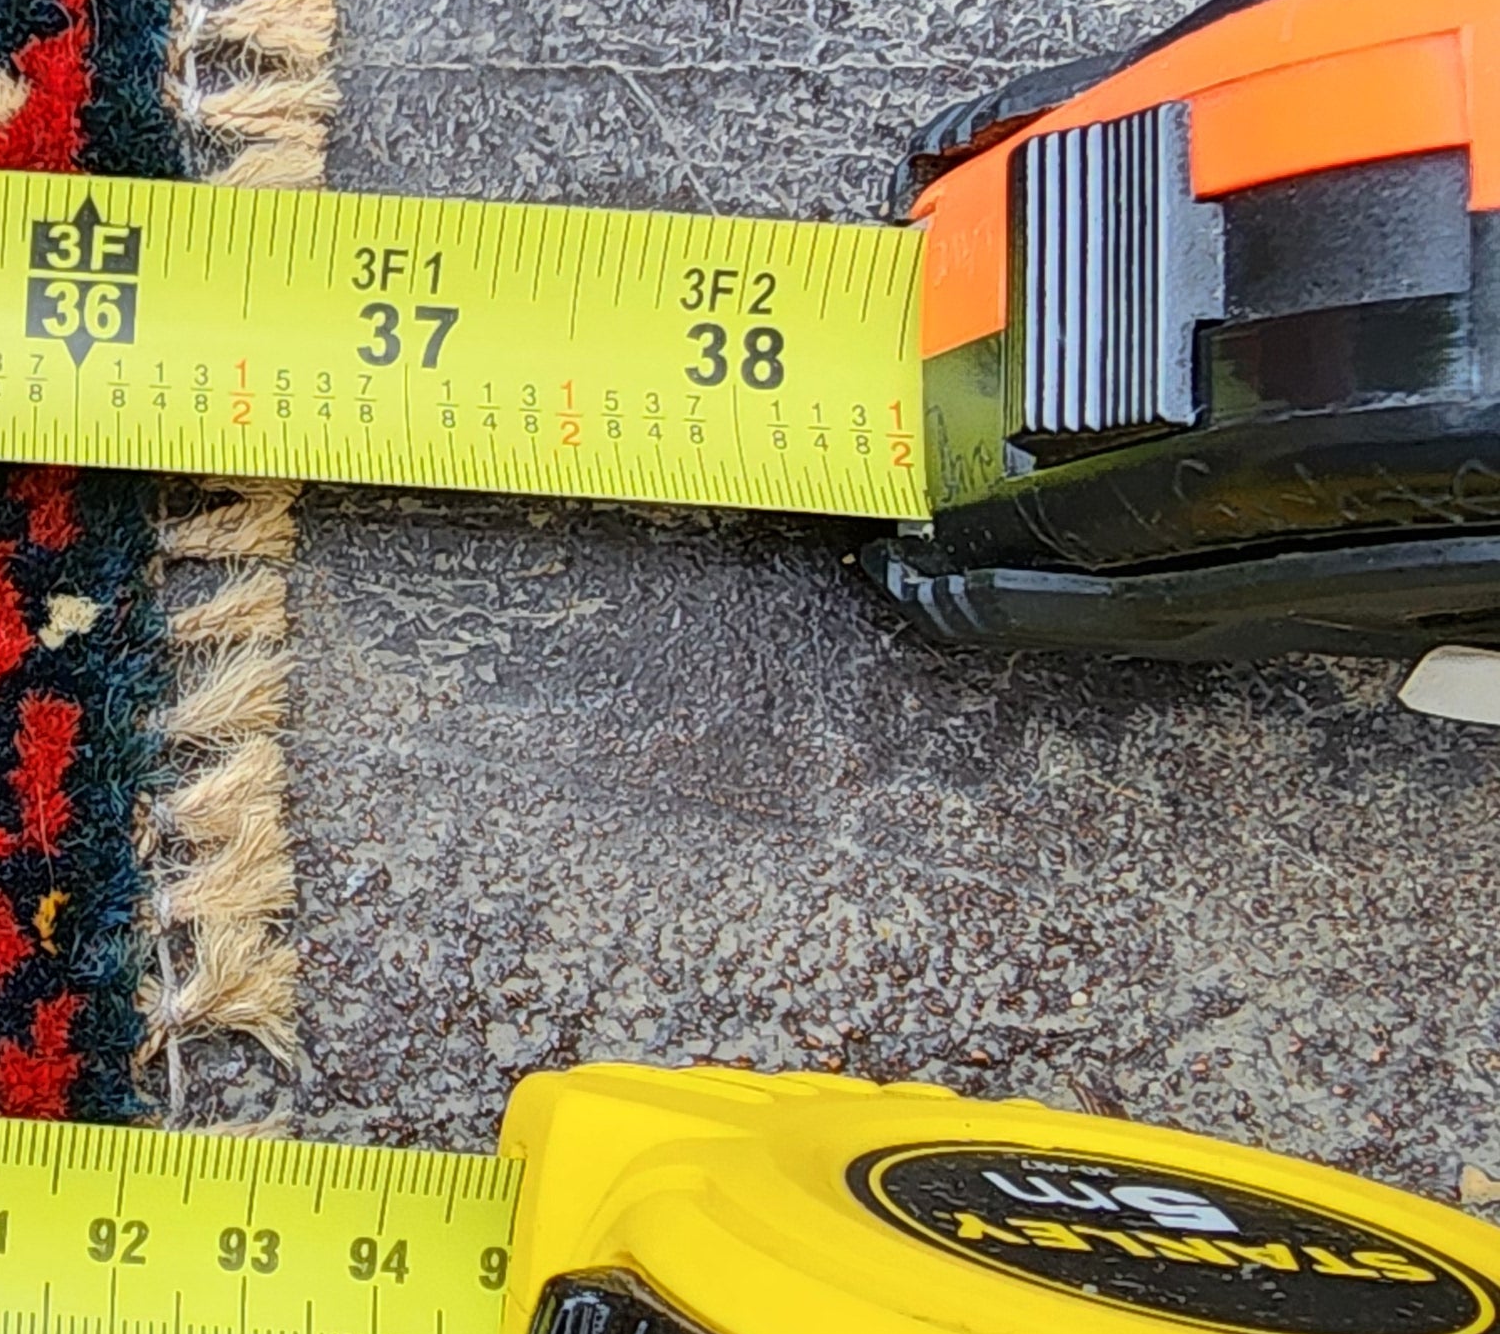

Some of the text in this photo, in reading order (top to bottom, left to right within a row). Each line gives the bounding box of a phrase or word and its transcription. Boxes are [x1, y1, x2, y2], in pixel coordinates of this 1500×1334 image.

[47, 225, 130, 271] 3F
[41, 281, 123, 340] 36
[357, 302, 459, 369] 37
[684, 323, 785, 390] 38
[981, 1172, 1240, 1233] 5m
[87, 1218, 149, 1265] 92
[218, 1227, 280, 1274] 93
[348, 1236, 409, 1284] 94
[479, 1247, 512, 1291] 9
[955, 1211, 1436, 1282] STANLEY
